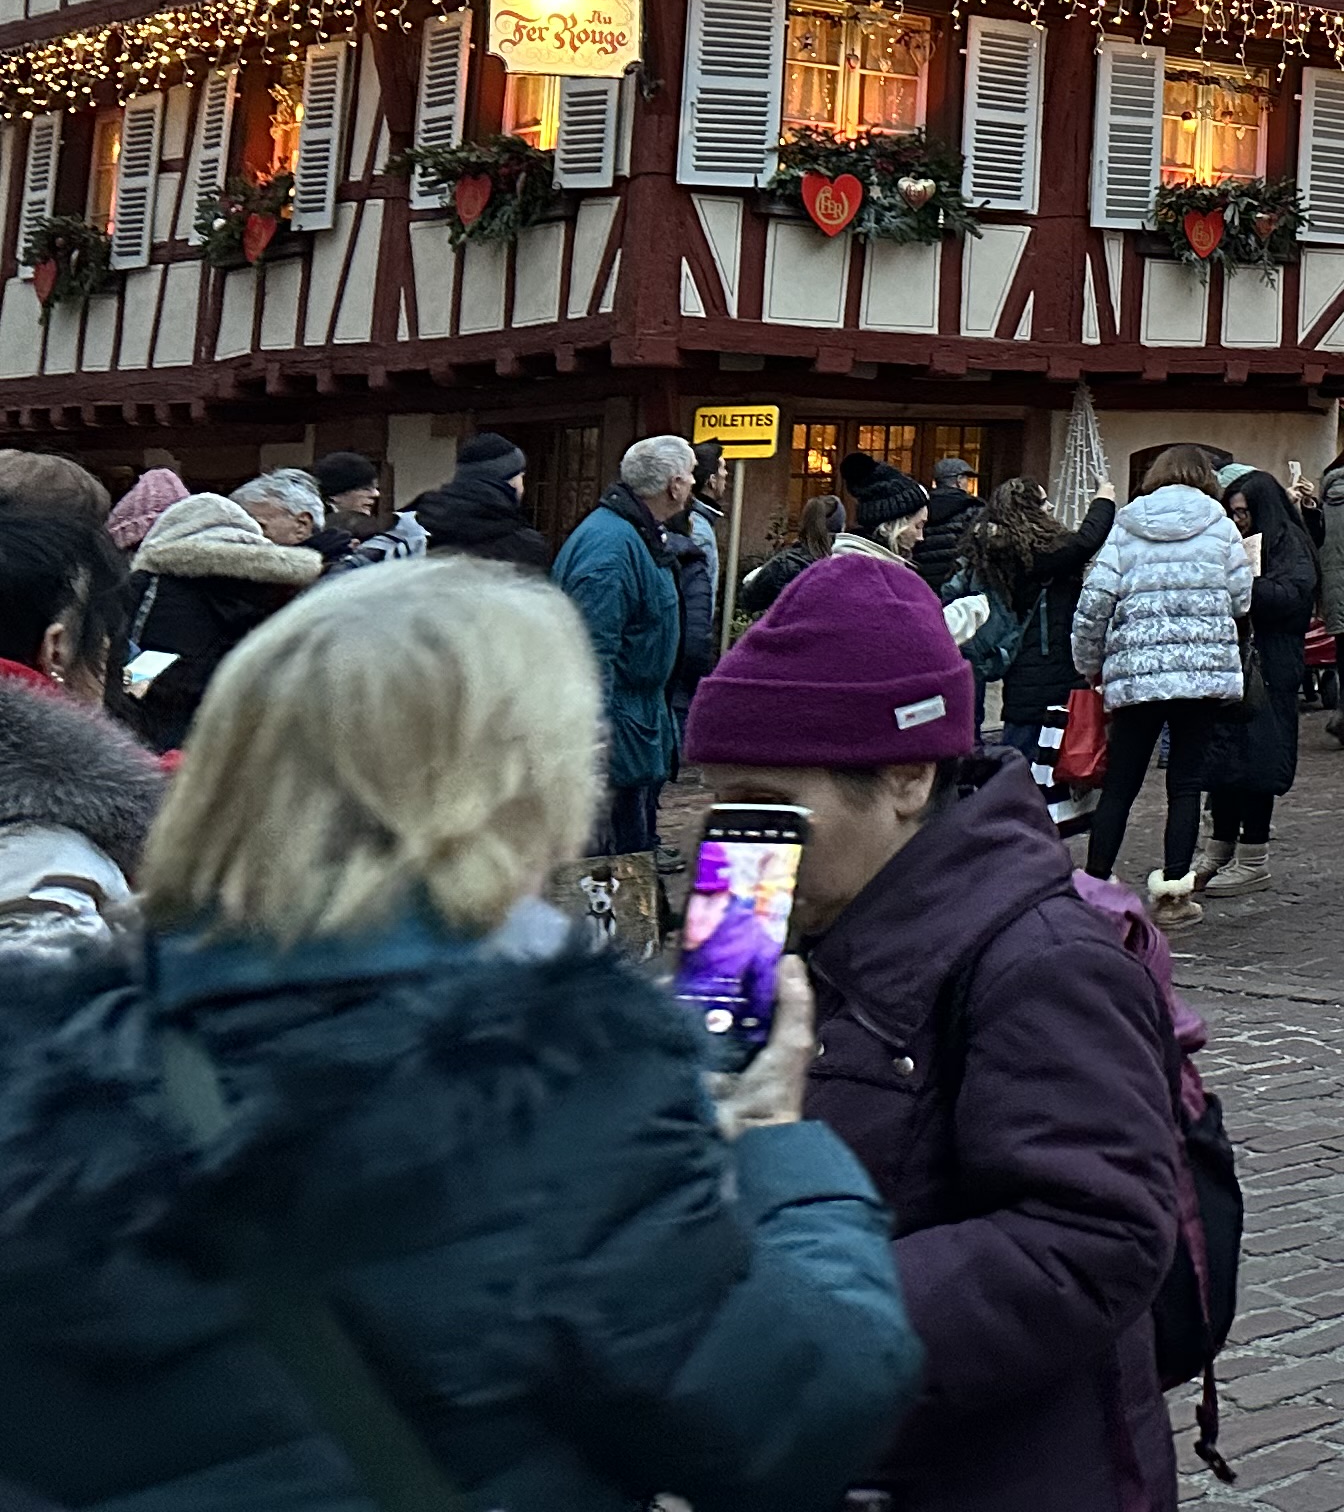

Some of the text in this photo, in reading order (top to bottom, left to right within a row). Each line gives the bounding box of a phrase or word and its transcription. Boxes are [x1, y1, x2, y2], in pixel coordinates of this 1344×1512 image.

[494, 9, 628, 56] Fer Rouge
[700, 413, 774, 428] TOILETTES
